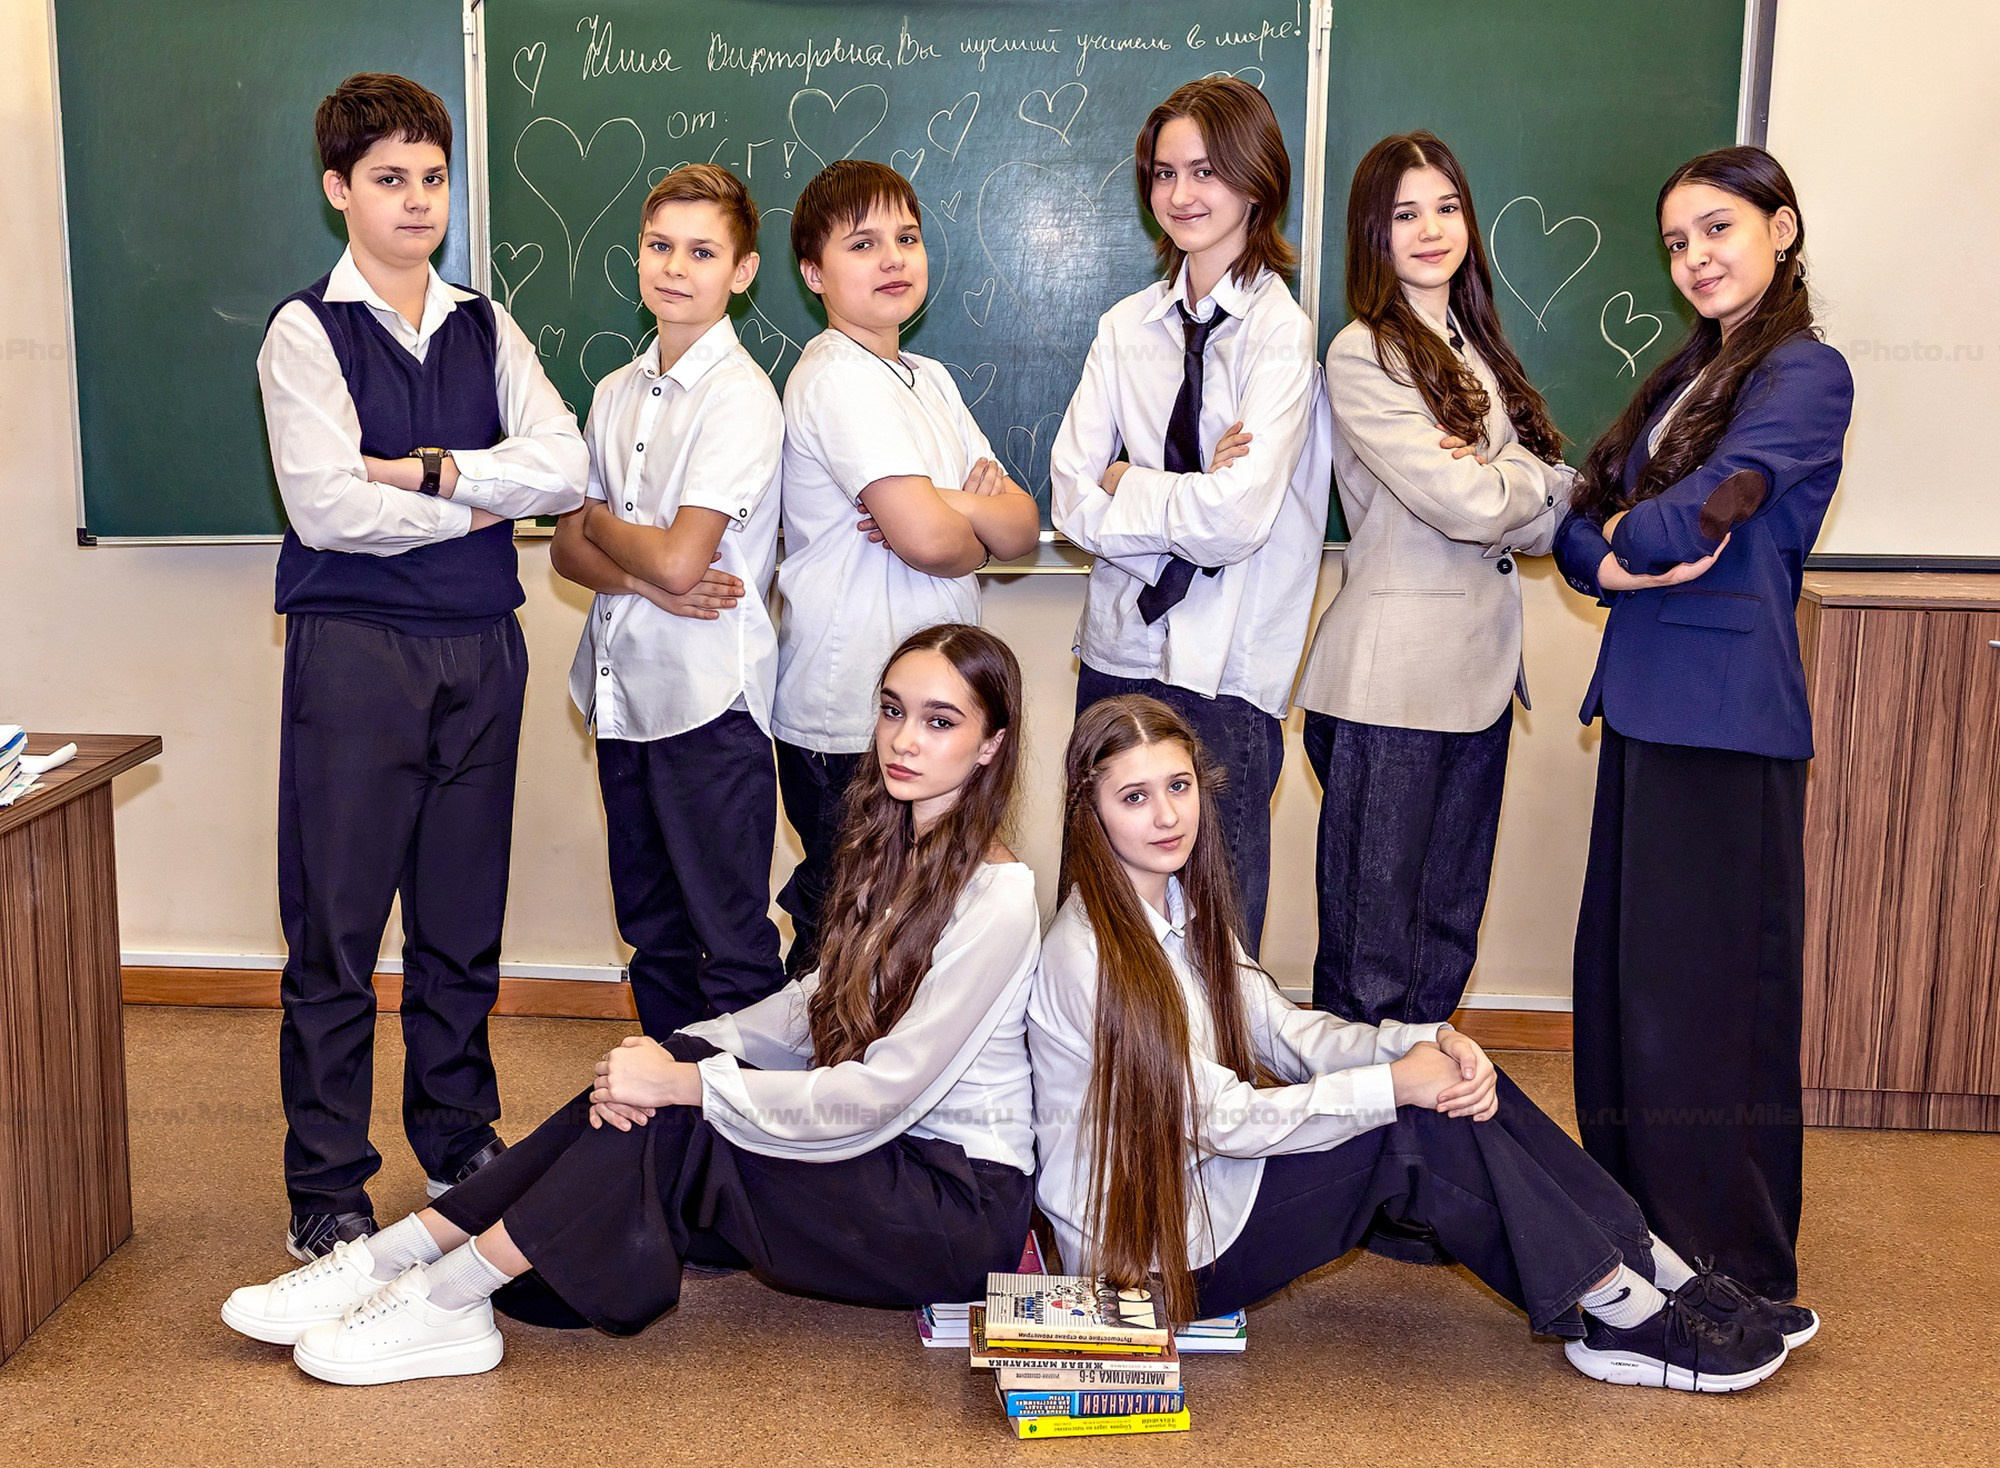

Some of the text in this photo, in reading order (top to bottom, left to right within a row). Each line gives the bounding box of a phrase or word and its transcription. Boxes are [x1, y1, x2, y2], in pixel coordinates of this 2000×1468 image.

[960, 28, 1063, 72] лучший
[1076, 33, 1171, 77] учитель
[1186, 23, 1206, 50] в
[988, 1359, 1058, 1369] МАТЕМАТИКА
[1061, 1361, 1103, 1370] ЖИВАЯ
[1079, 1370, 1165, 1385] МАТЕМАТИКА 5-6
